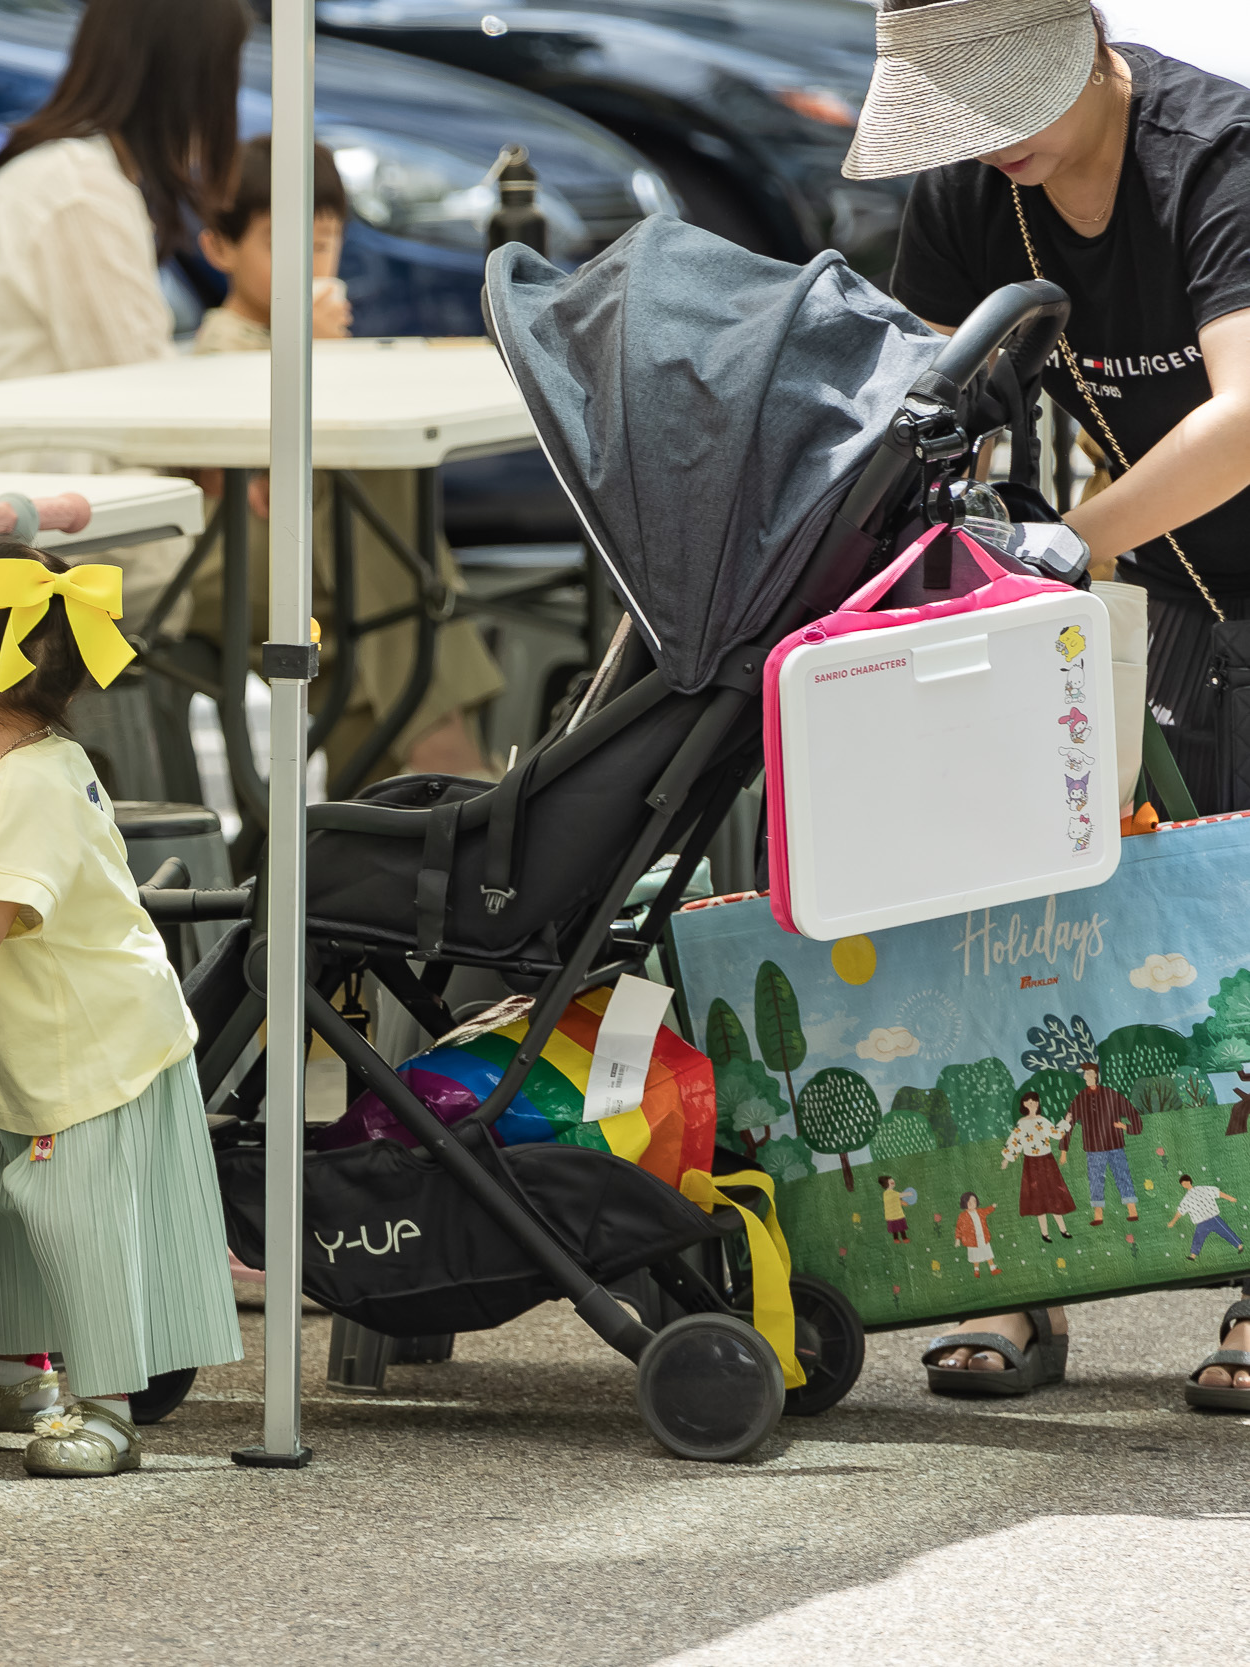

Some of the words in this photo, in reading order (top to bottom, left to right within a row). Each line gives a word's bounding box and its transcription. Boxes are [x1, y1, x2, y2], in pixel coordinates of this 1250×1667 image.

[1103, 345, 1202, 377] HILFIGER
[814, 669, 848, 683] SANRIO
[850, 658, 907, 676] CHARACTERS
[953, 894, 1109, 981] Holidays
[314, 1219, 421, 1263] Y-UP
